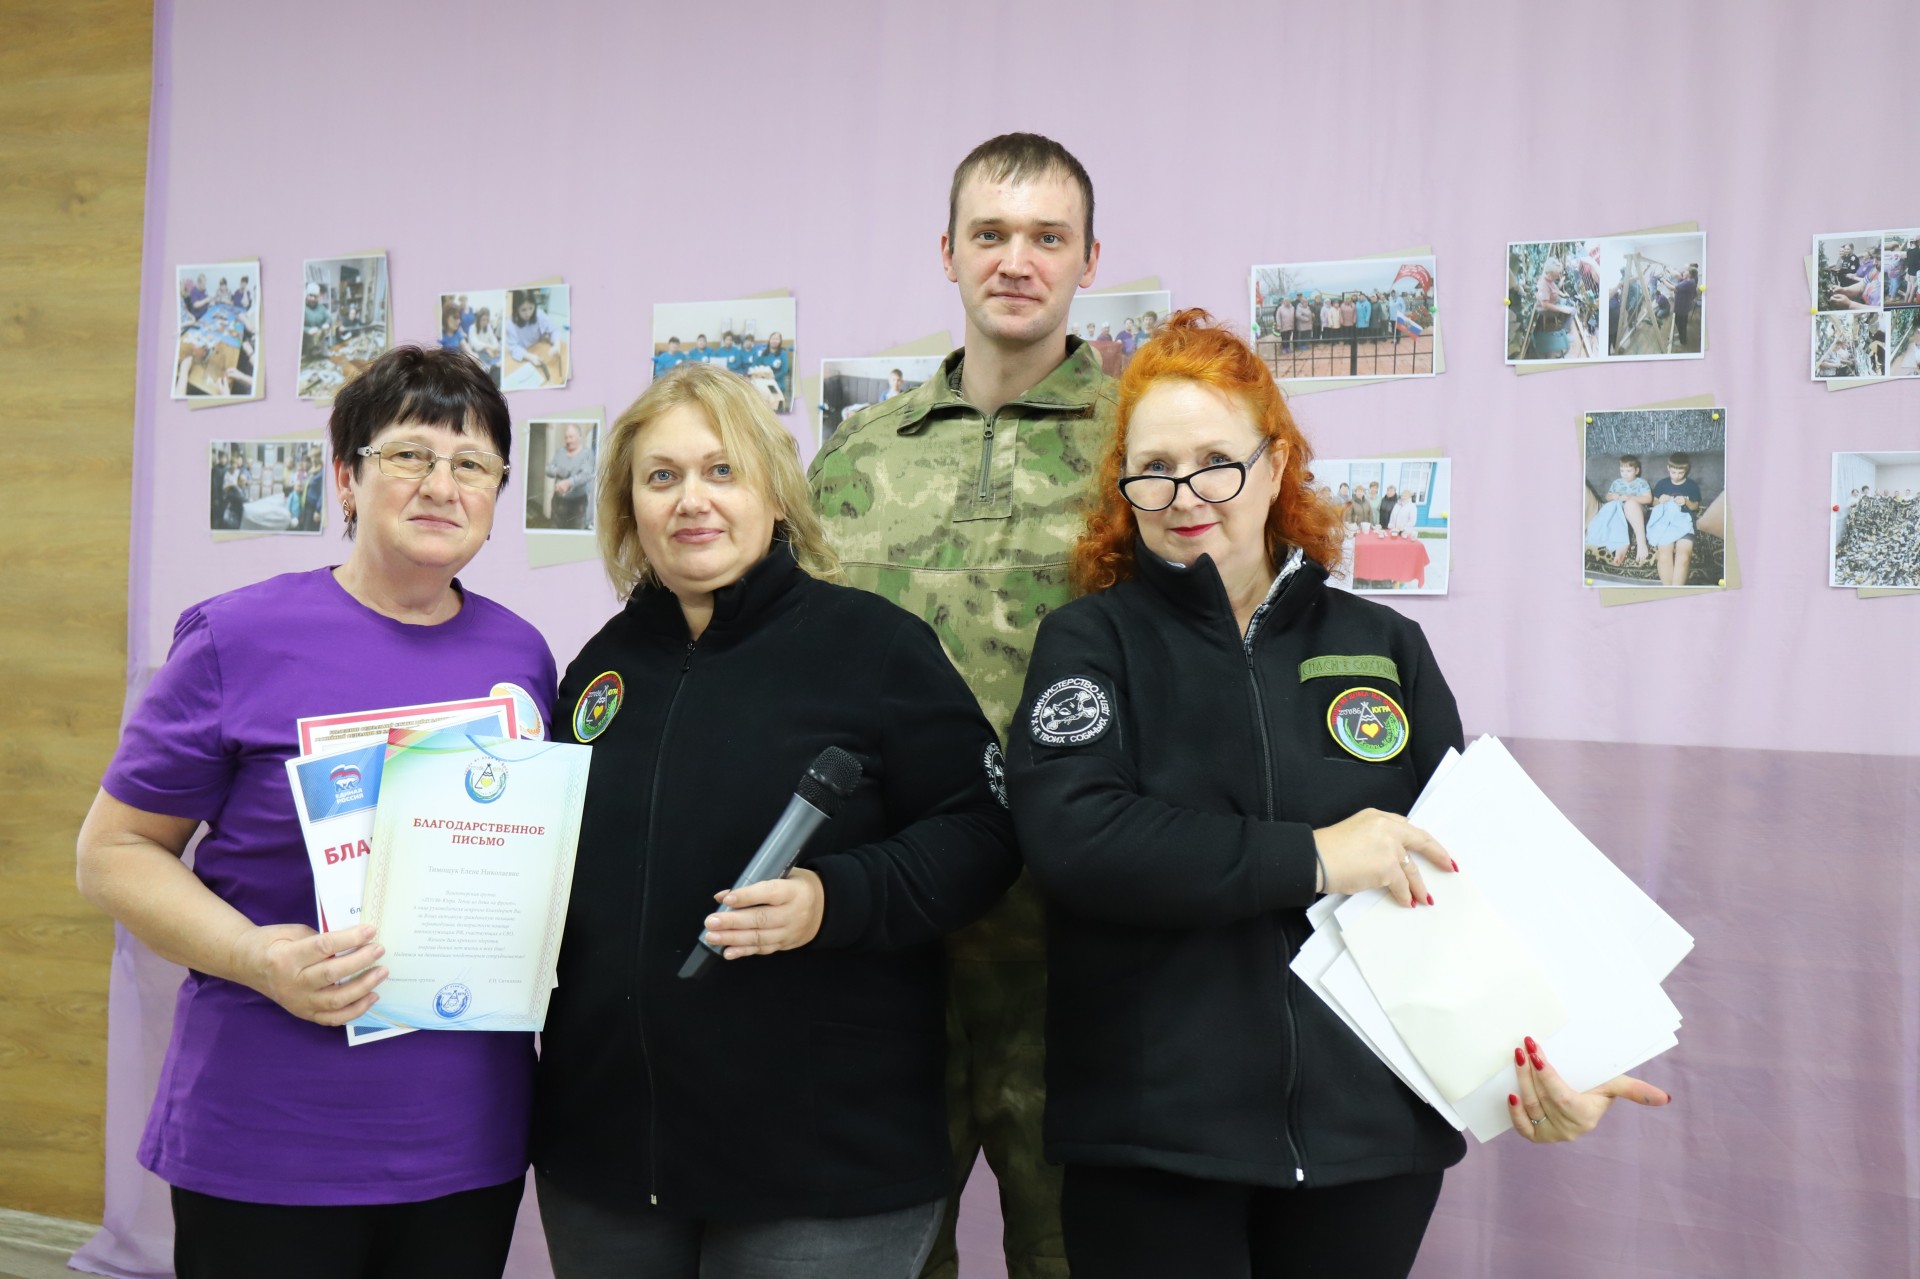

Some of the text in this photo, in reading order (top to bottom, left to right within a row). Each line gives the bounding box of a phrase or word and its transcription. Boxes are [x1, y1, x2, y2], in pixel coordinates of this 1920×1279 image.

[1033, 678, 1099, 717] МИНИСТЕРСТВО
[1371, 705, 1391, 715] ЮГРА
[1031, 726, 1039, 736] НЕ
[1039, 733, 1065, 744] ТВОИХ
[1070, 717, 1108, 743] СОБАЧЬИХ
[335, 788, 363, 798] ЕДИНАЯ
[336, 793, 364, 804] РОССИЯ
[413, 818, 546, 836] БЛАГОДАРСТВЕННОЕ
[451, 834, 505, 847] ПИСЬМО
[324, 838, 371, 866] БЛА
[460, 867, 480, 876] Елене
